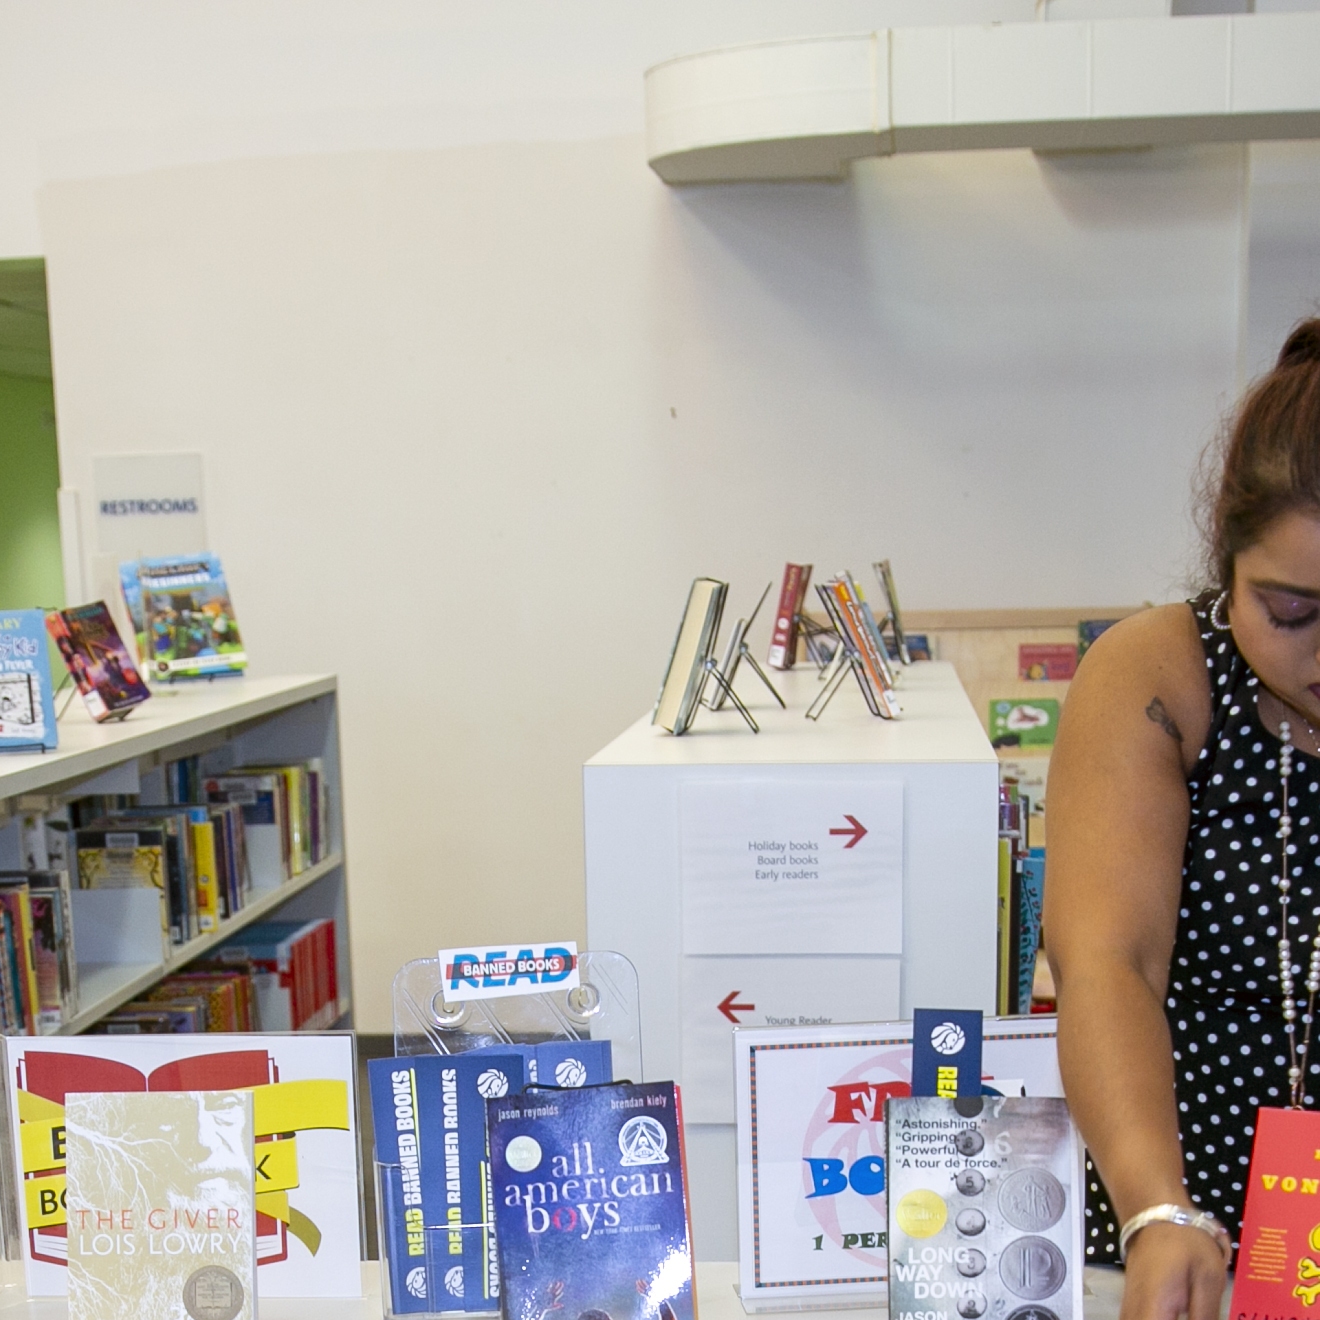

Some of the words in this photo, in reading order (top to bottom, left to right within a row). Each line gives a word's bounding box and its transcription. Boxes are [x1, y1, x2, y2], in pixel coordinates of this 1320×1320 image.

[100, 498, 197, 515] RESTROOMS
[748, 840, 787, 853] Holiday
[789, 840, 819, 851] books
[757, 855, 787, 866] Board
[789, 855, 819, 866] books
[755, 869, 779, 881] Early
[782, 869, 819, 880] readers
[463, 963, 516, 977] BANNED
[517, 958, 560, 973] BOOKS
[610, 1096, 644, 1110] brendan
[646, 1092, 668, 1108] kiely
[497, 1108, 520, 1121] jason
[523, 1105, 559, 1119] reynolds
[552, 1141, 594, 1179] all
[504, 1168, 674, 1207] american
[76, 1208, 134, 1230] THE
[148, 1208, 243, 1230] GIVER
[525, 1194, 620, 1240] boys
[78, 1233, 135, 1256] LOIS
[148, 1232, 242, 1255] LOWRY
[908, 1246, 970, 1265] LONG
[895, 1265, 944, 1282] WAY
[914, 1282, 984, 1300] DOWN
